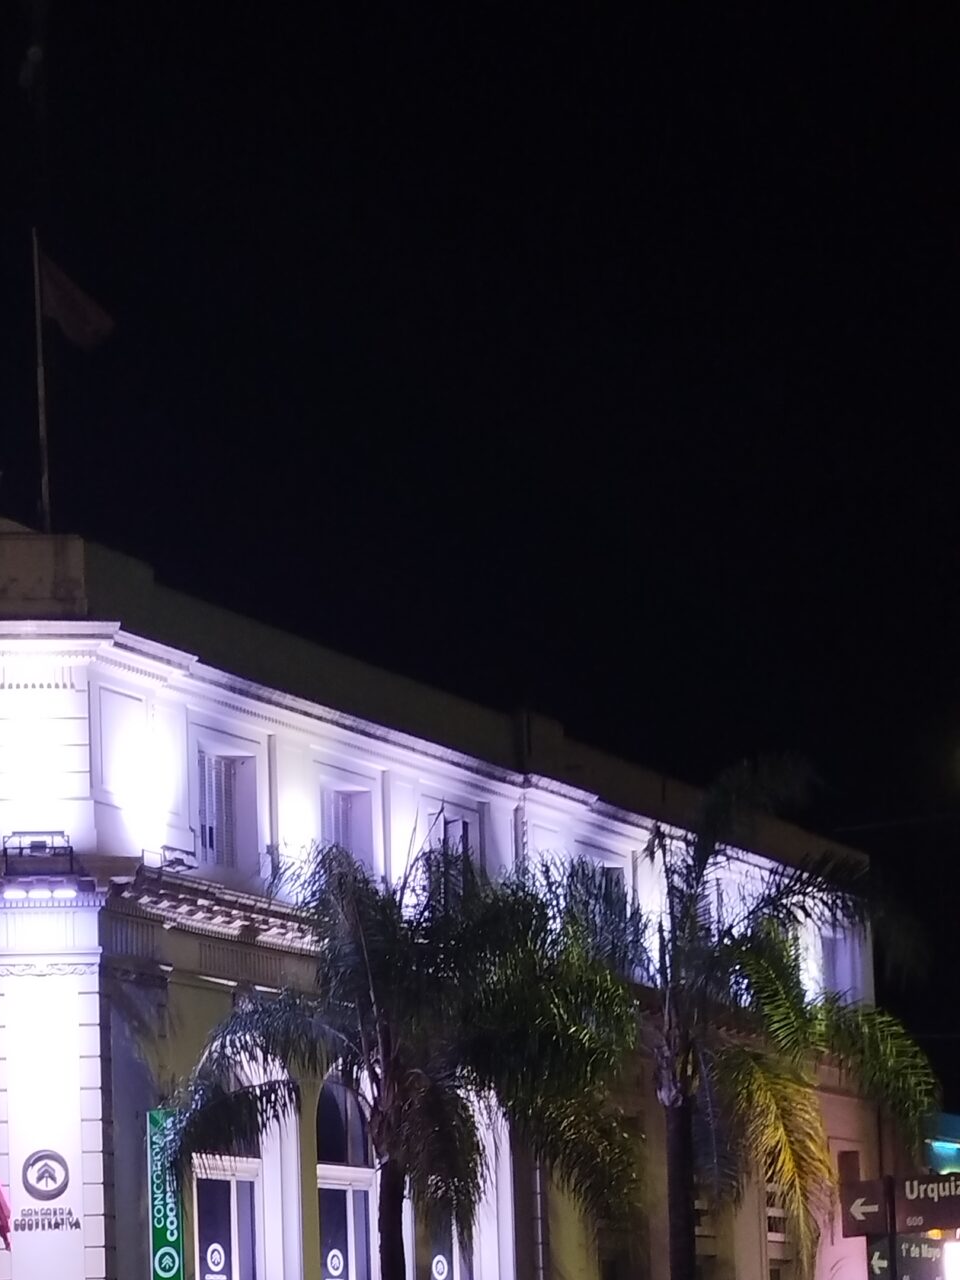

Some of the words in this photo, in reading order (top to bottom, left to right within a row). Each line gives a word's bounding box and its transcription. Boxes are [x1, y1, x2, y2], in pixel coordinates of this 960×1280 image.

[21, 1207, 73, 1217] CONCORDIA
[13, 1217, 81, 1232] COOPERATIVA
[906, 1216, 924, 1226] 600
[910, 1243, 920, 1258] de
[921, 1244, 941, 1261] Mayo
